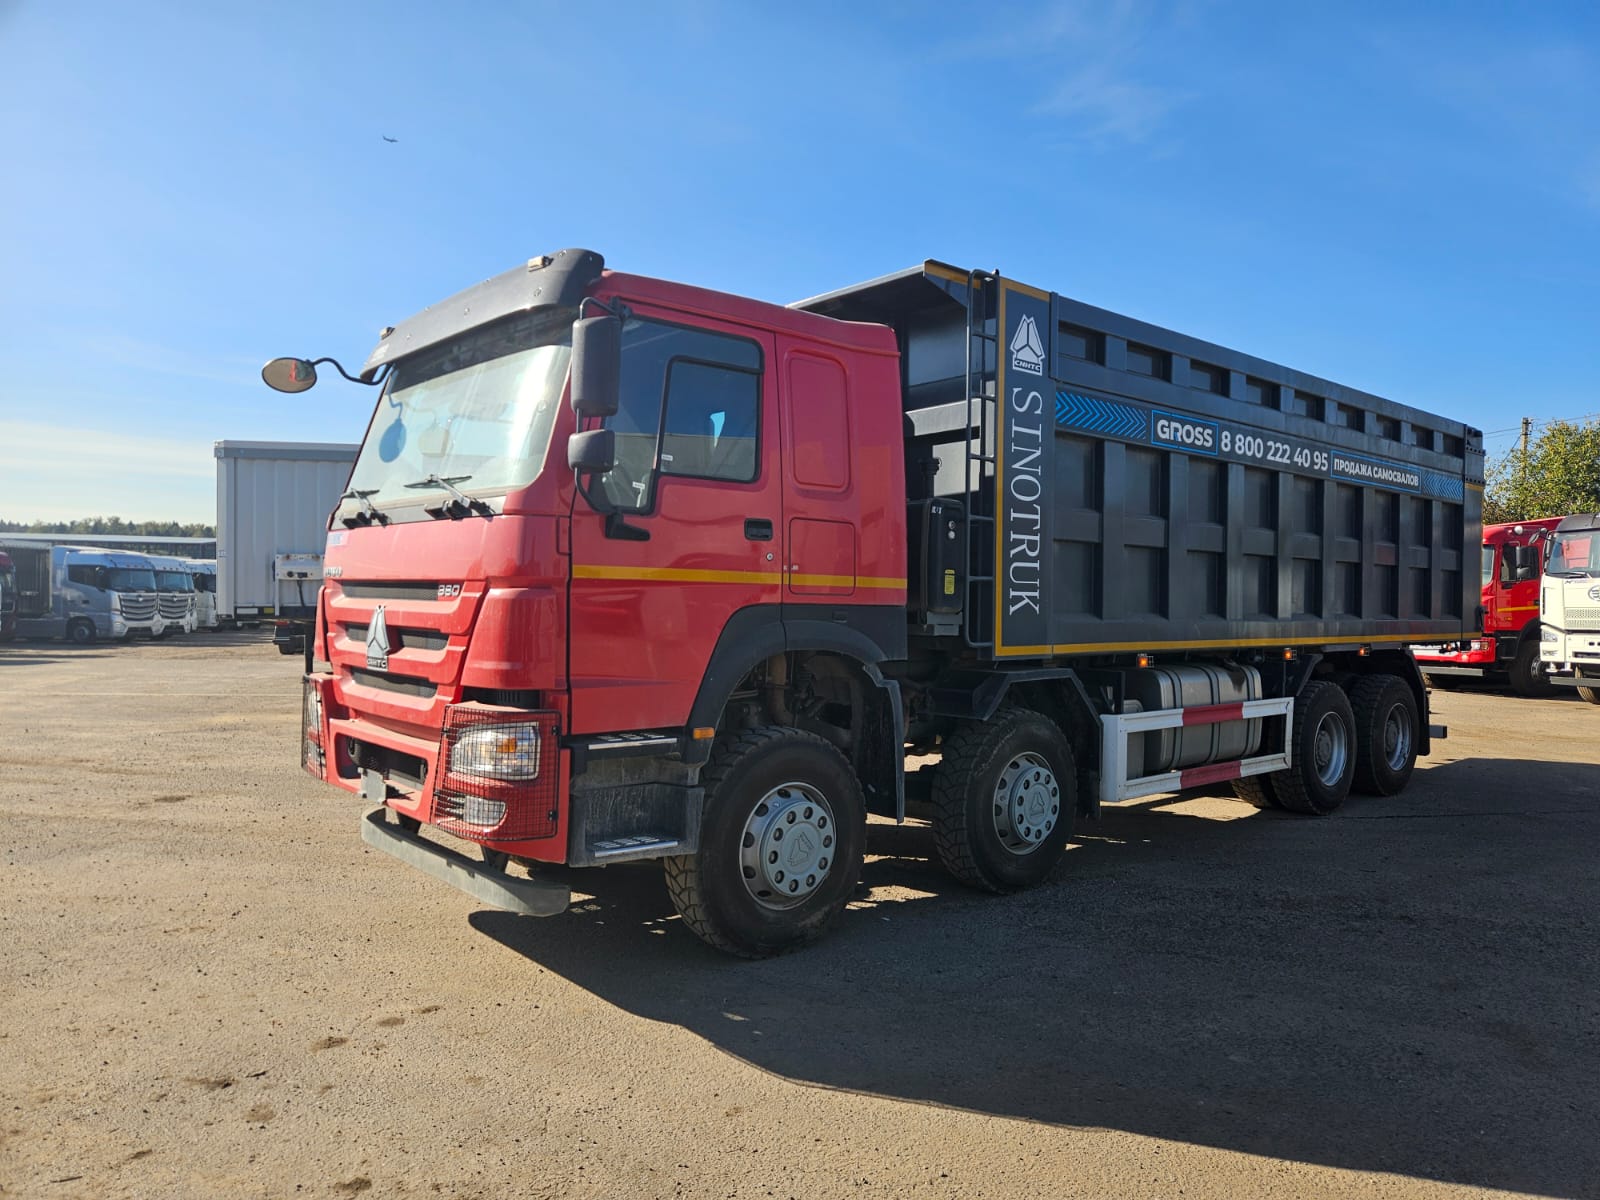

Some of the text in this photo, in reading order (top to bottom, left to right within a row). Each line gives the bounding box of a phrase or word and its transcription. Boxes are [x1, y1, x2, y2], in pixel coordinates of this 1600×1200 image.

[1014, 360, 1041, 372] CNHTC
[1156, 419, 1213, 448] GROSS
[1220, 431, 1329, 472] 8 800 222 40 95
[1334, 458, 1419, 486] ПРОДАЖА САМОСВАЛОВ
[1010, 387, 1043, 616] SINOTRUK
